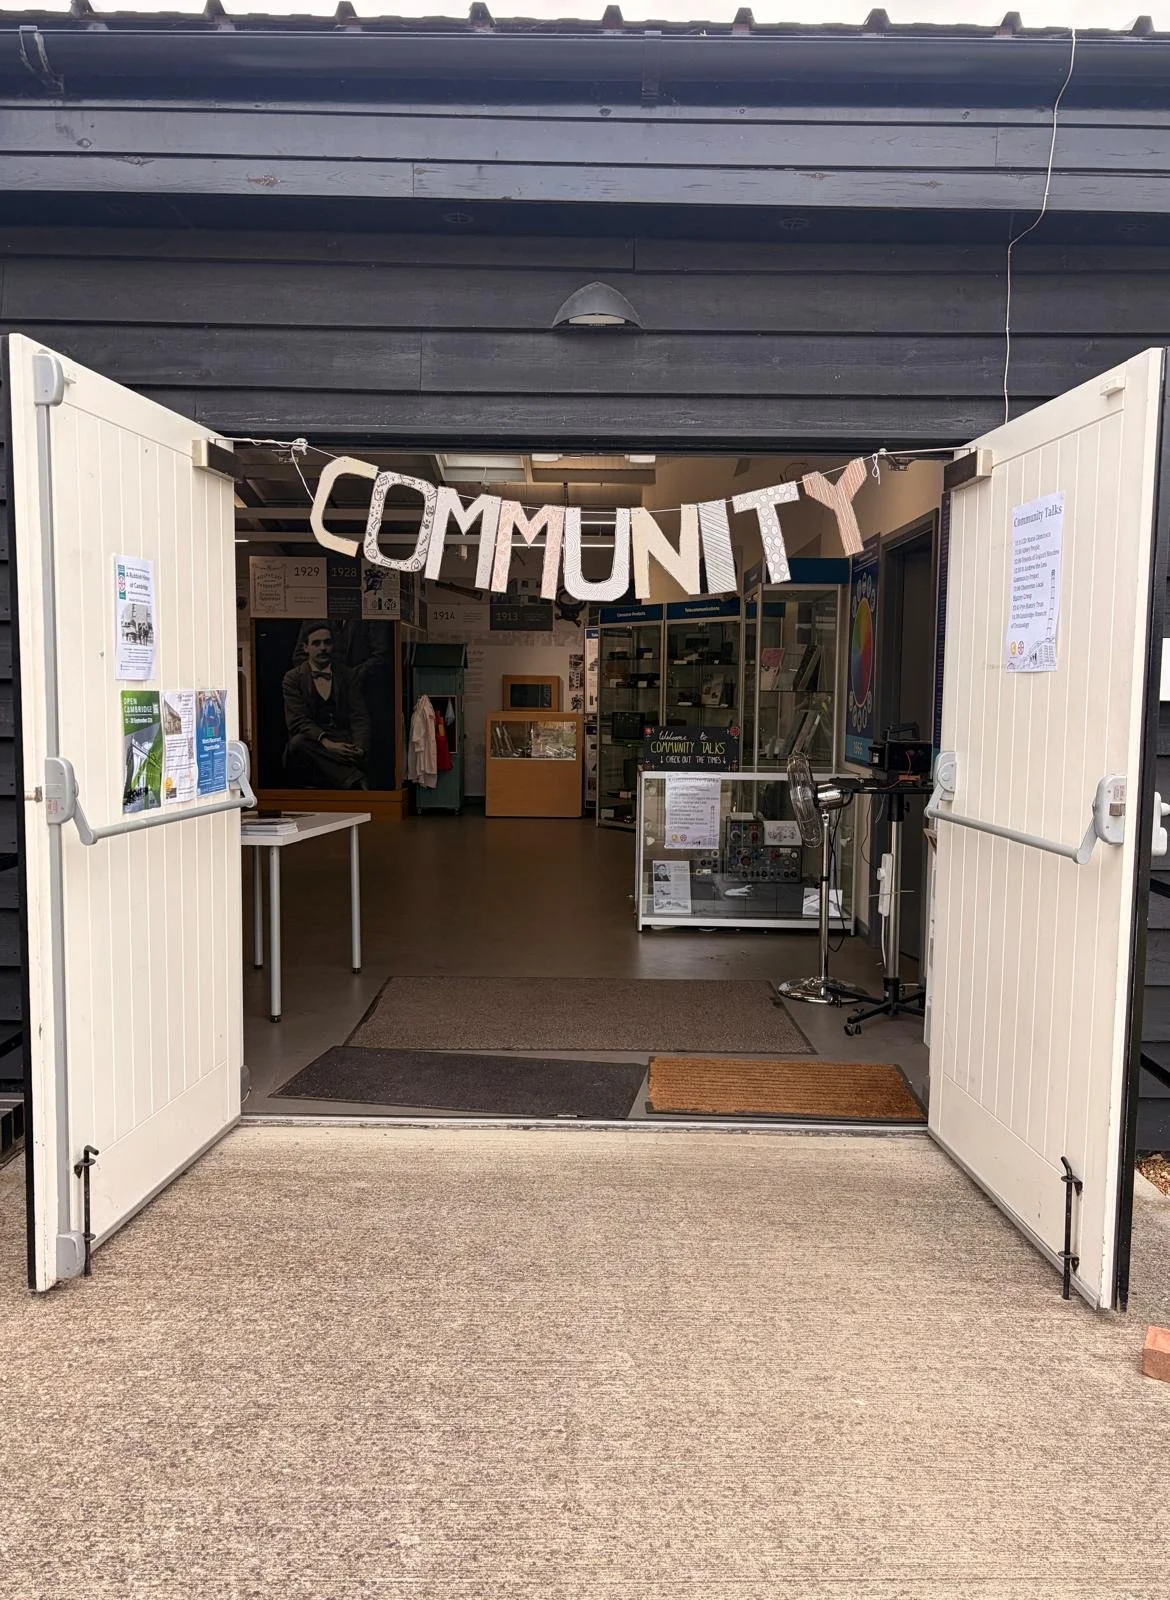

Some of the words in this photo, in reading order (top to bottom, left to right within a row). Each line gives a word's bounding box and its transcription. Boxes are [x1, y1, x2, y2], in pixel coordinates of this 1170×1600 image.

[1013, 508, 1043, 528] Community
[1045, 504, 1063, 518] Talks
[309, 456, 868, 602] COMMUNITY
[294, 567, 320, 577] 1929
[331, 567, 357, 577] 1928
[433, 611, 455, 620] 1914
[496, 612, 518, 621] 1913
[123, 697, 138, 705] OPEN
[123, 705, 153, 713] CAMBRIDGE
[659, 730, 688, 740] Welcome
[700, 731, 709, 740] to
[650, 741, 695, 754] COMMUNITY
[701, 742, 726, 755] TALKS
[665, 755, 681, 764] CHECK
[681, 755, 691, 764] OUT
[696, 755, 705, 764] THE
[707, 755, 722, 764] TIMES
